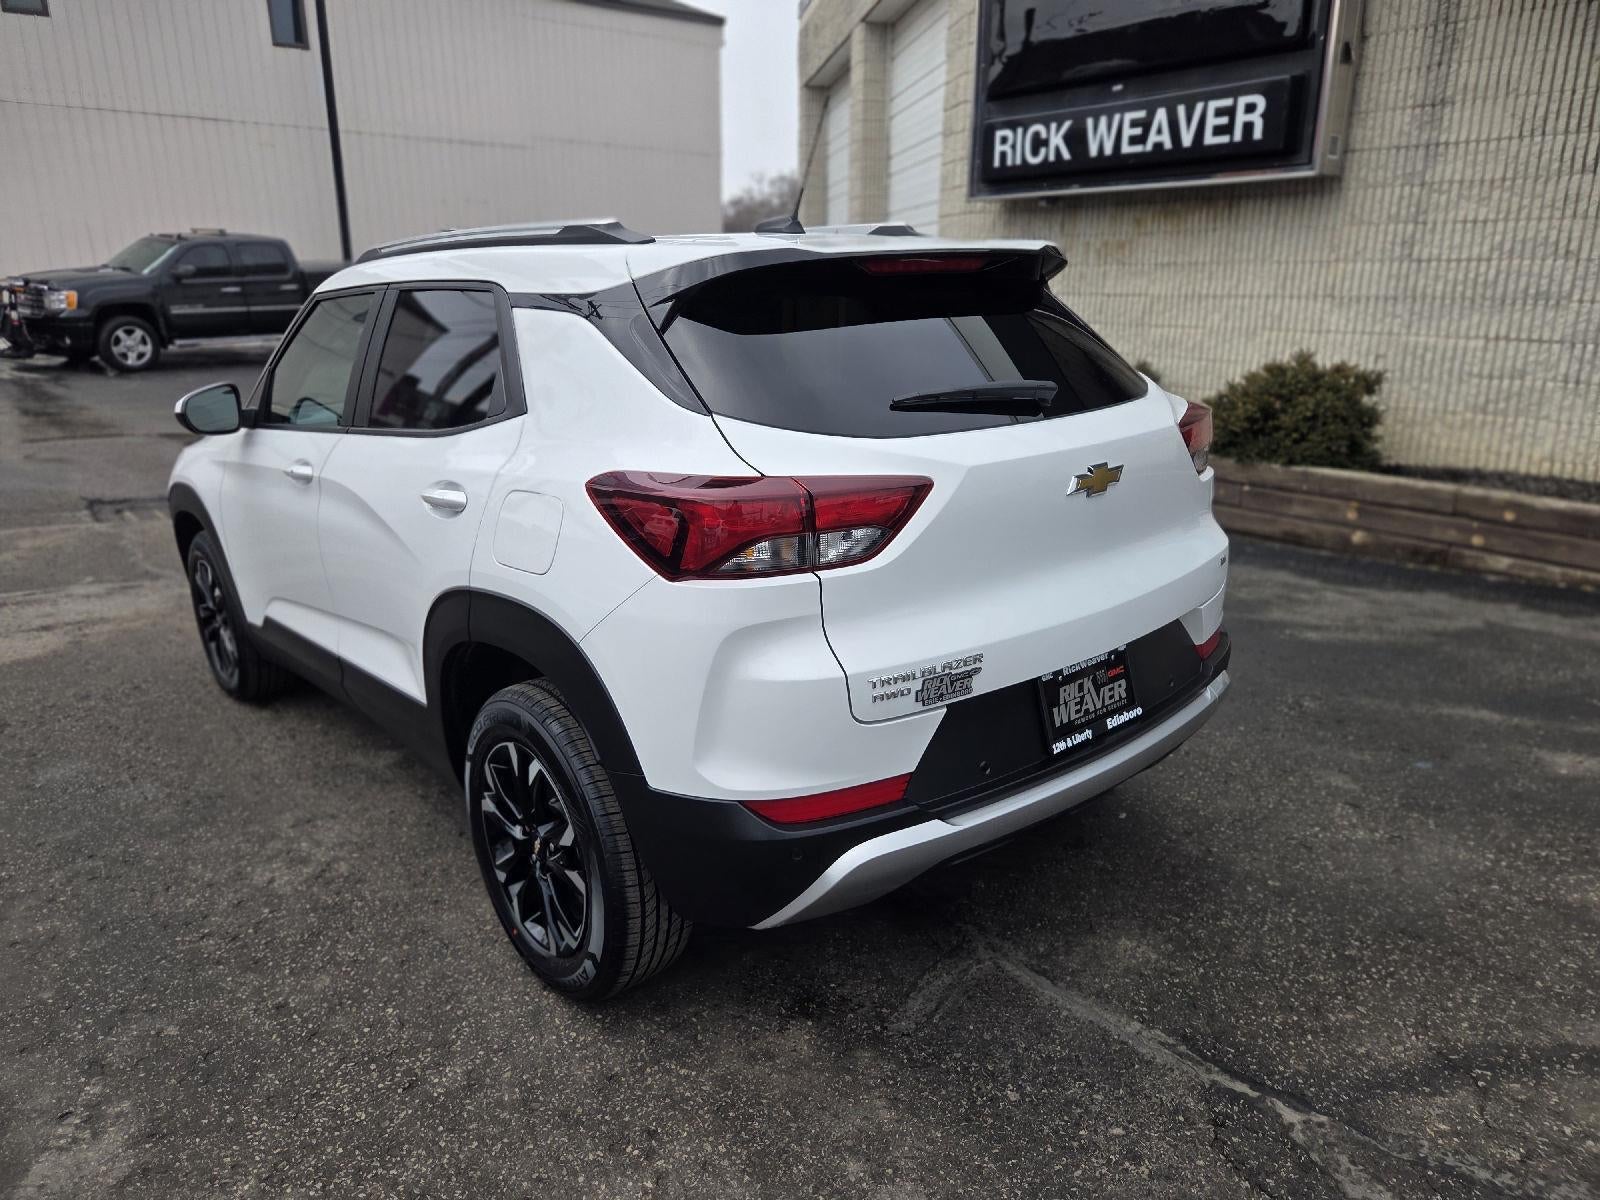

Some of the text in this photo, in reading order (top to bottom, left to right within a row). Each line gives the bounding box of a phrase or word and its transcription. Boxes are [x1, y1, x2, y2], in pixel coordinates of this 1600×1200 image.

[993, 94, 1267, 168] RICK WEAVER
[868, 652, 984, 689] TRAILBLAZER
[925, 673, 951, 689] RICK
[872, 687, 911, 703] AWD
[917, 678, 974, 701] WEAVER
[924, 696, 940, 706] ERIE
[1060, 675, 1094, 705] RICK
[1053, 679, 1127, 728] WEAVER
[1106, 706, 1143, 730] Edinboro
[1052, 740, 1067, 755] 12th
[1072, 729, 1093, 746] Liberty
